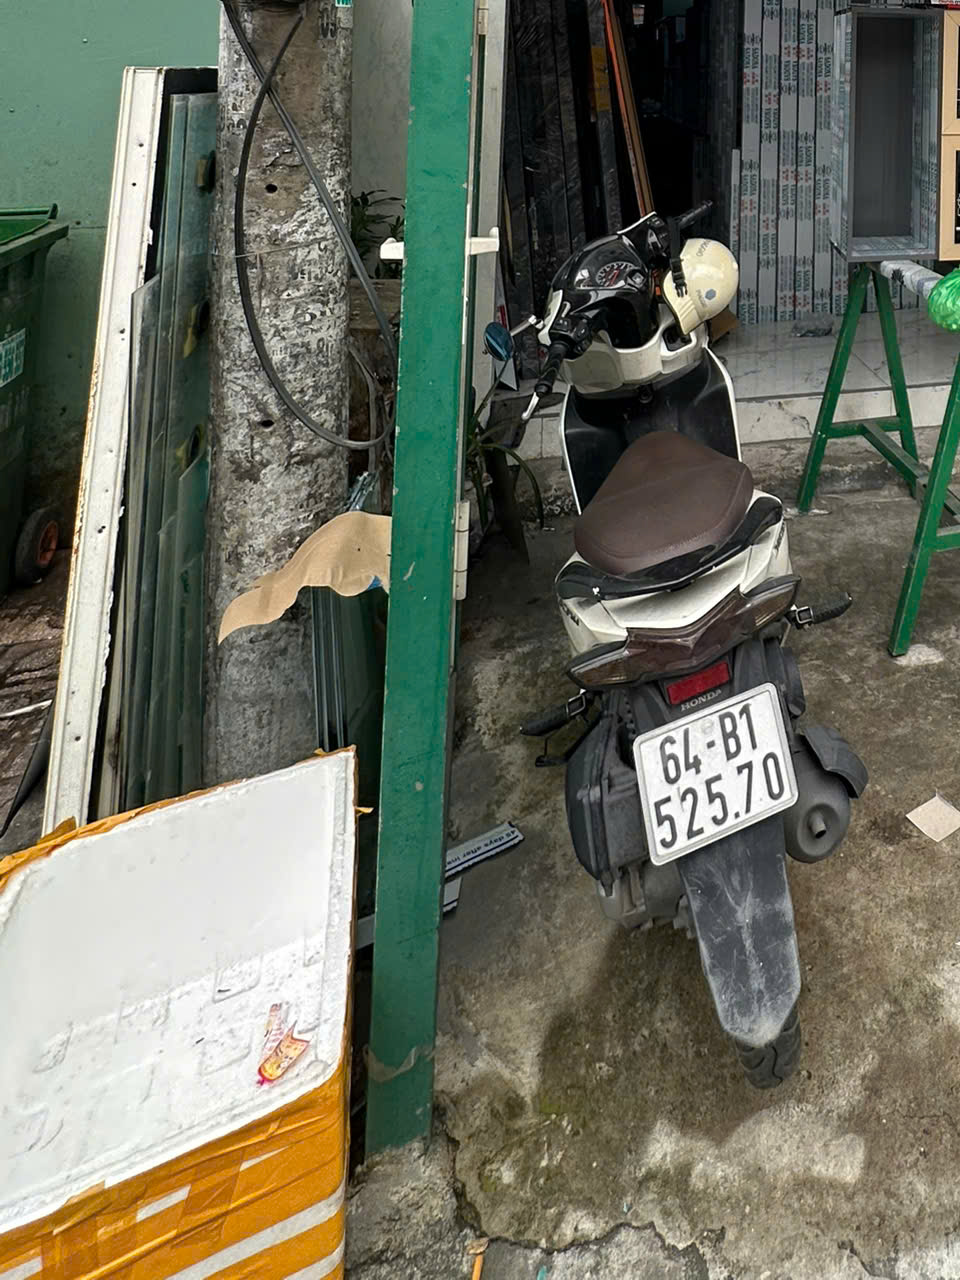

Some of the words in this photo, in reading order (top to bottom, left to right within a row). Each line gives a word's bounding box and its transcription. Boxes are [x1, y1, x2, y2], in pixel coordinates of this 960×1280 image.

[680, 688, 723, 712] HONDA
[659, 703, 758, 786] 64-B1
[653, 751, 786, 850] 525.70
